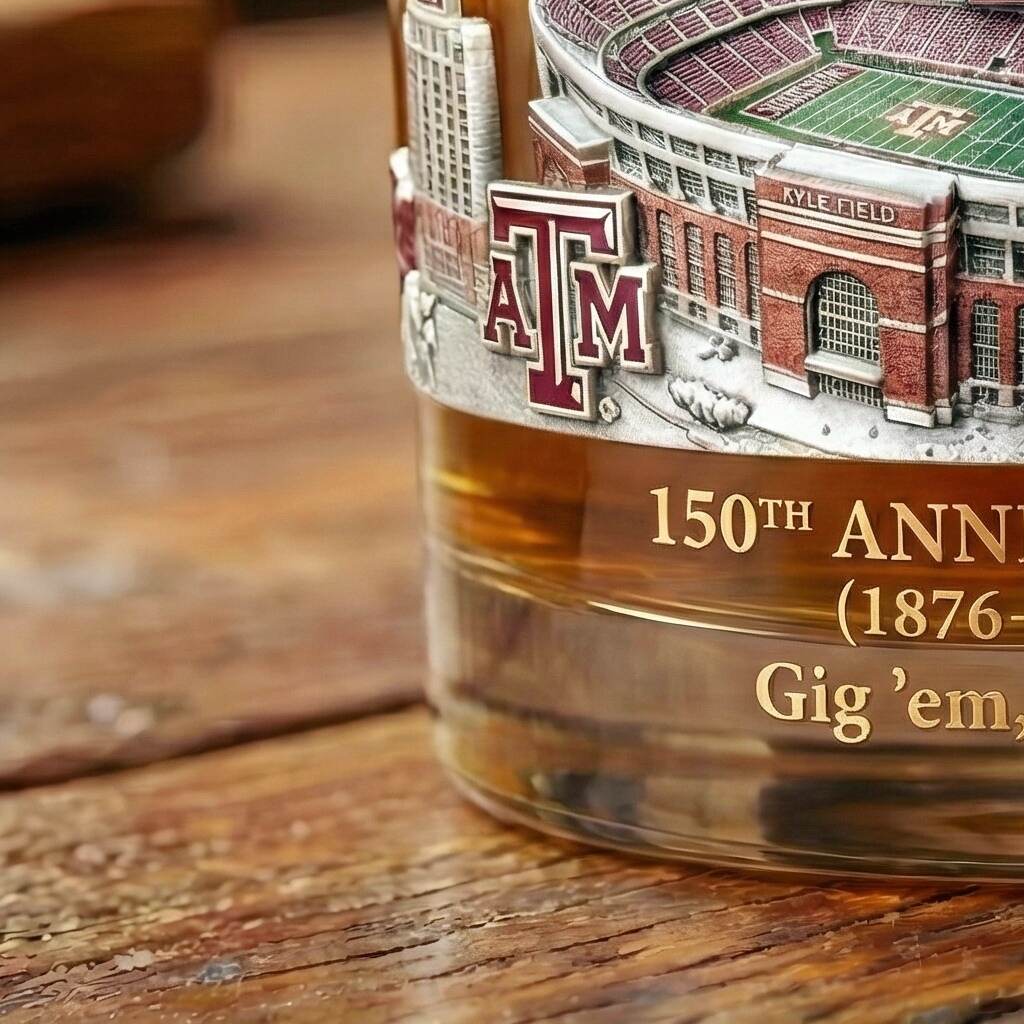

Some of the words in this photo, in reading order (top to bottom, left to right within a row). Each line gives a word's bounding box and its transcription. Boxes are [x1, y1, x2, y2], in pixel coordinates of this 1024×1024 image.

[782, 187, 830, 211] KYLE
[650, 486, 813, 553] 150TH
[755, 662, 871, 744] Gig
